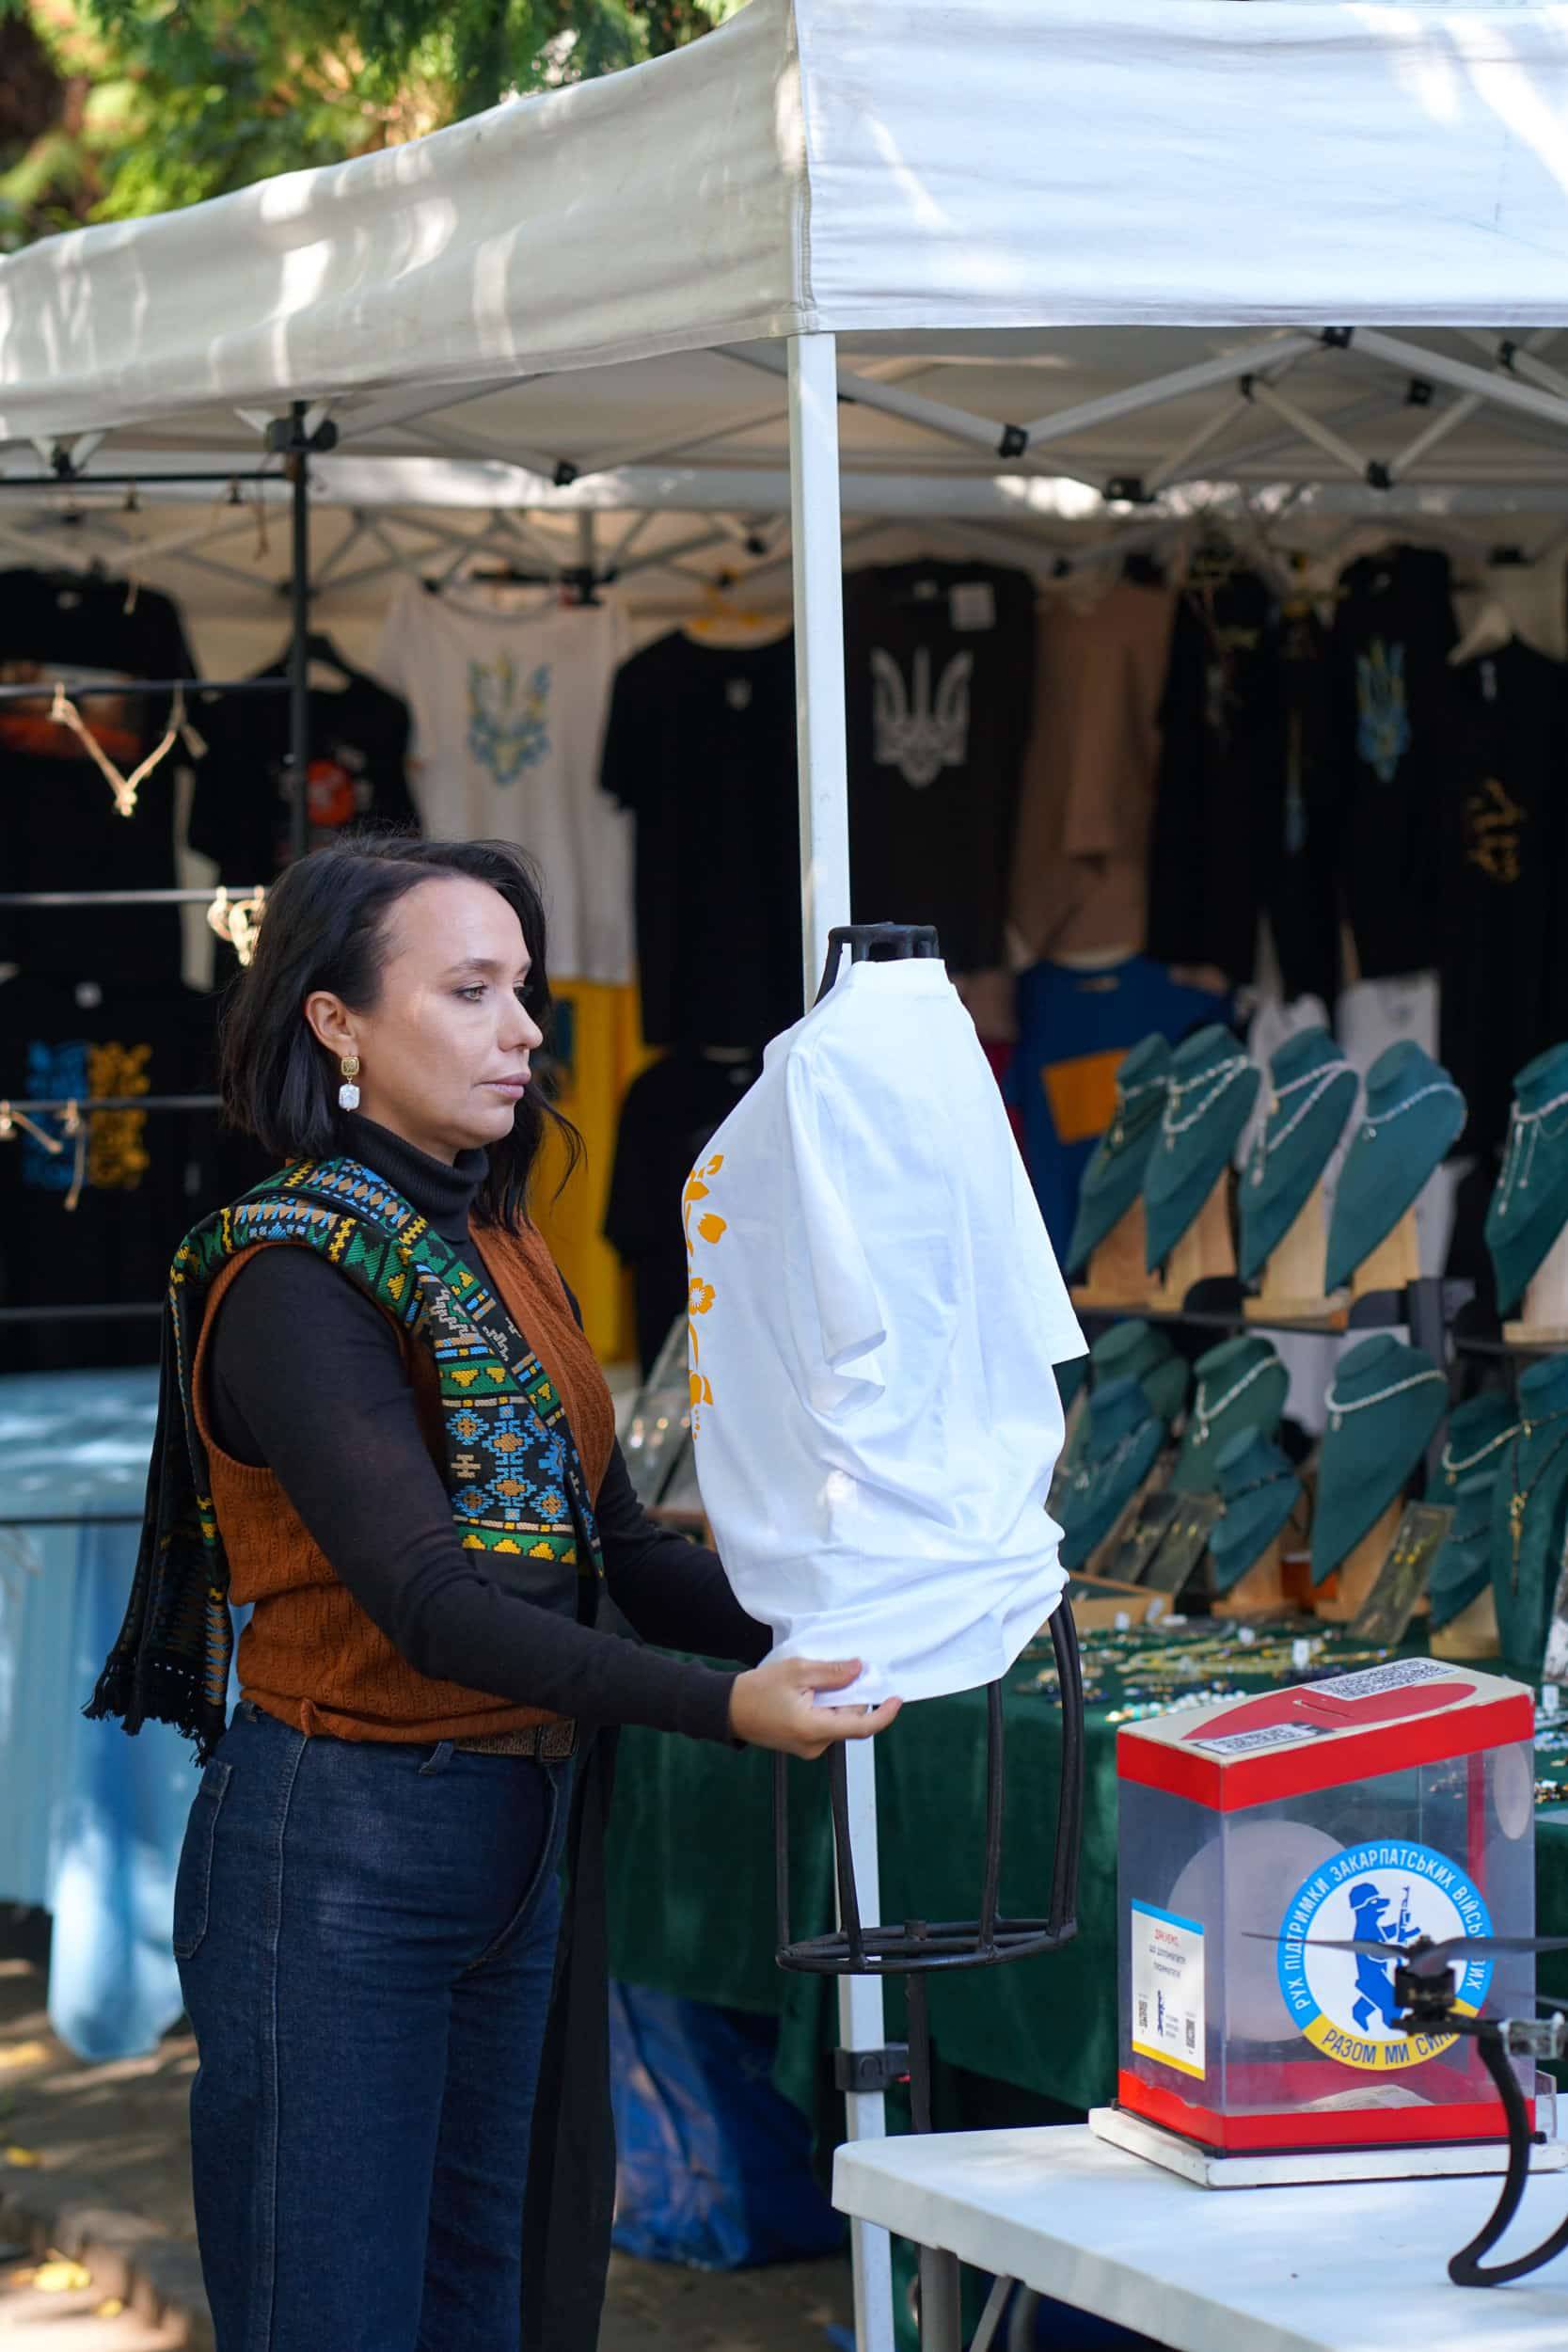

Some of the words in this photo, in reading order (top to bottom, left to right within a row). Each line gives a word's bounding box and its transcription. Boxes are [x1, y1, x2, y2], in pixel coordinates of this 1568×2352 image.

[1329, 1847, 1457, 1889] ЗАКАРПАТСЬКИХ
[1285, 1877, 1330, 1970] ПІДТРИМКИ
[1452, 1885, 1487, 1991] ВІЙСЬВИХ
[1287, 1977, 1311, 2010] РУХ
[1322, 2027, 1377, 2064] РАЗОМ
[1385, 2043, 1410, 2065] МИ
